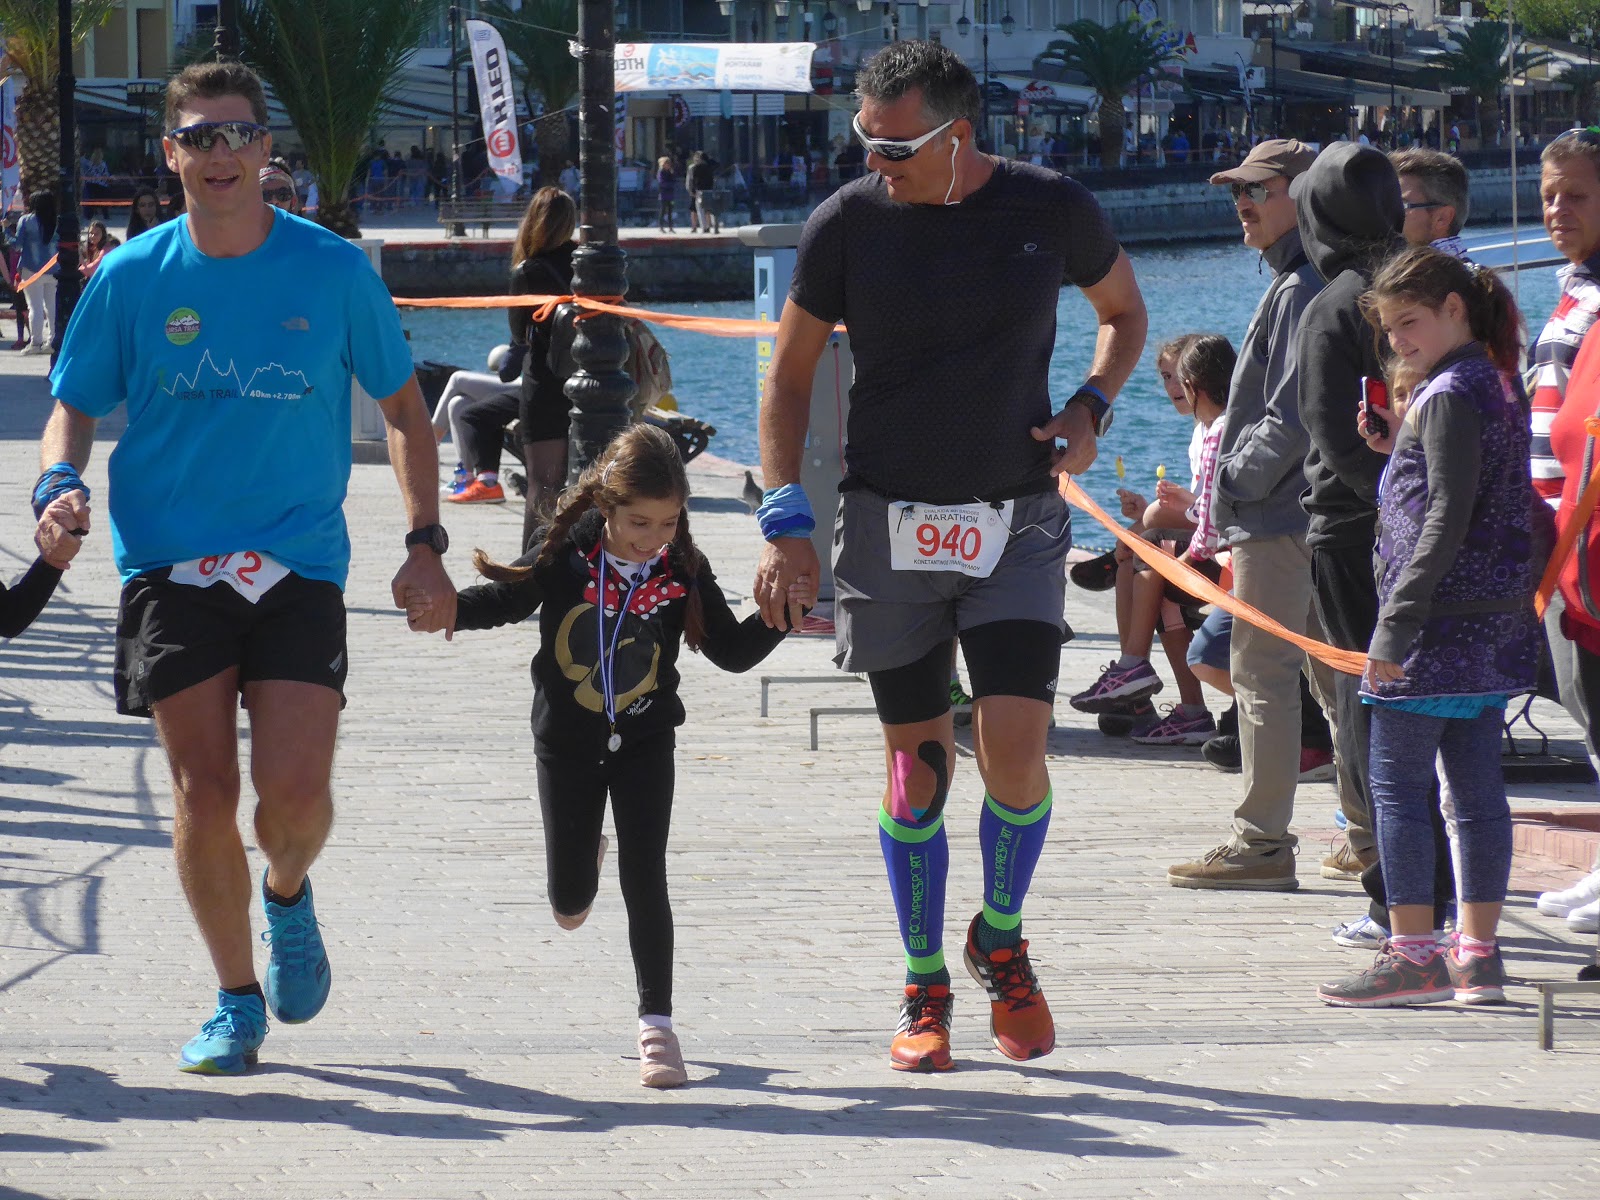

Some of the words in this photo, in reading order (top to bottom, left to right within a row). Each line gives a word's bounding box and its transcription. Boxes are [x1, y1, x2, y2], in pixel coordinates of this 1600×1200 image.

[176, 389, 205, 401] URSA
[209, 388, 239, 400] TRAIL
[924, 513, 979, 524] MARATHON
[916, 523, 982, 561] 940
